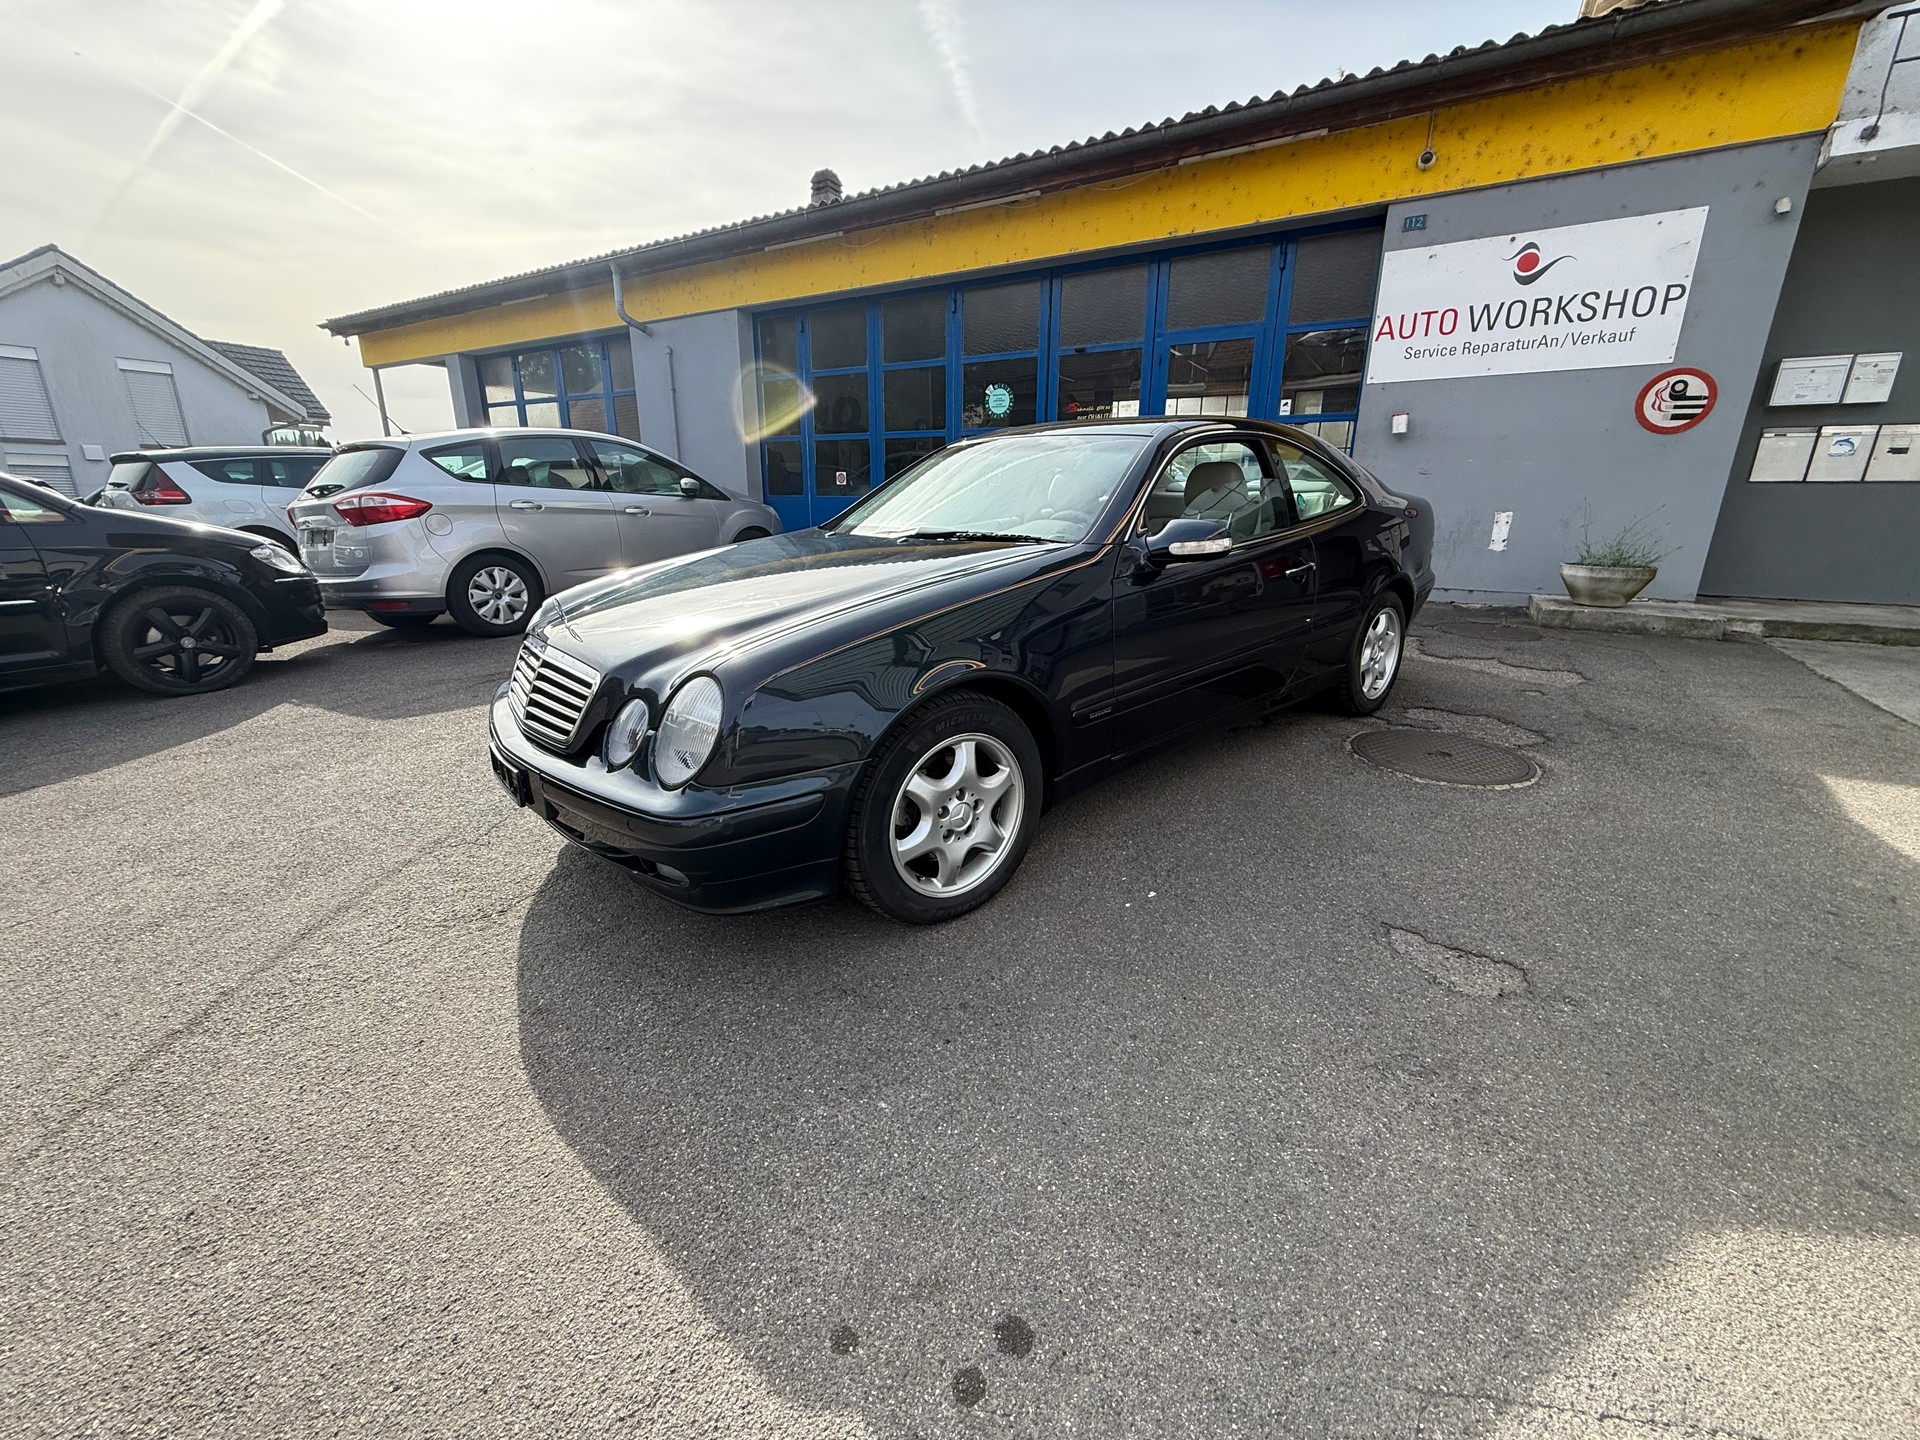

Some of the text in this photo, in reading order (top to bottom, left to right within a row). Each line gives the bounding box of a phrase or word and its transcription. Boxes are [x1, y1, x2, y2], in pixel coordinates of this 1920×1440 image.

[1405, 216, 1424, 229] 112
[1374, 283, 1687, 342] AUTO WORKSHOP
[1403, 344, 1457, 360] Service
[935, 713, 993, 734] MICHELIN
